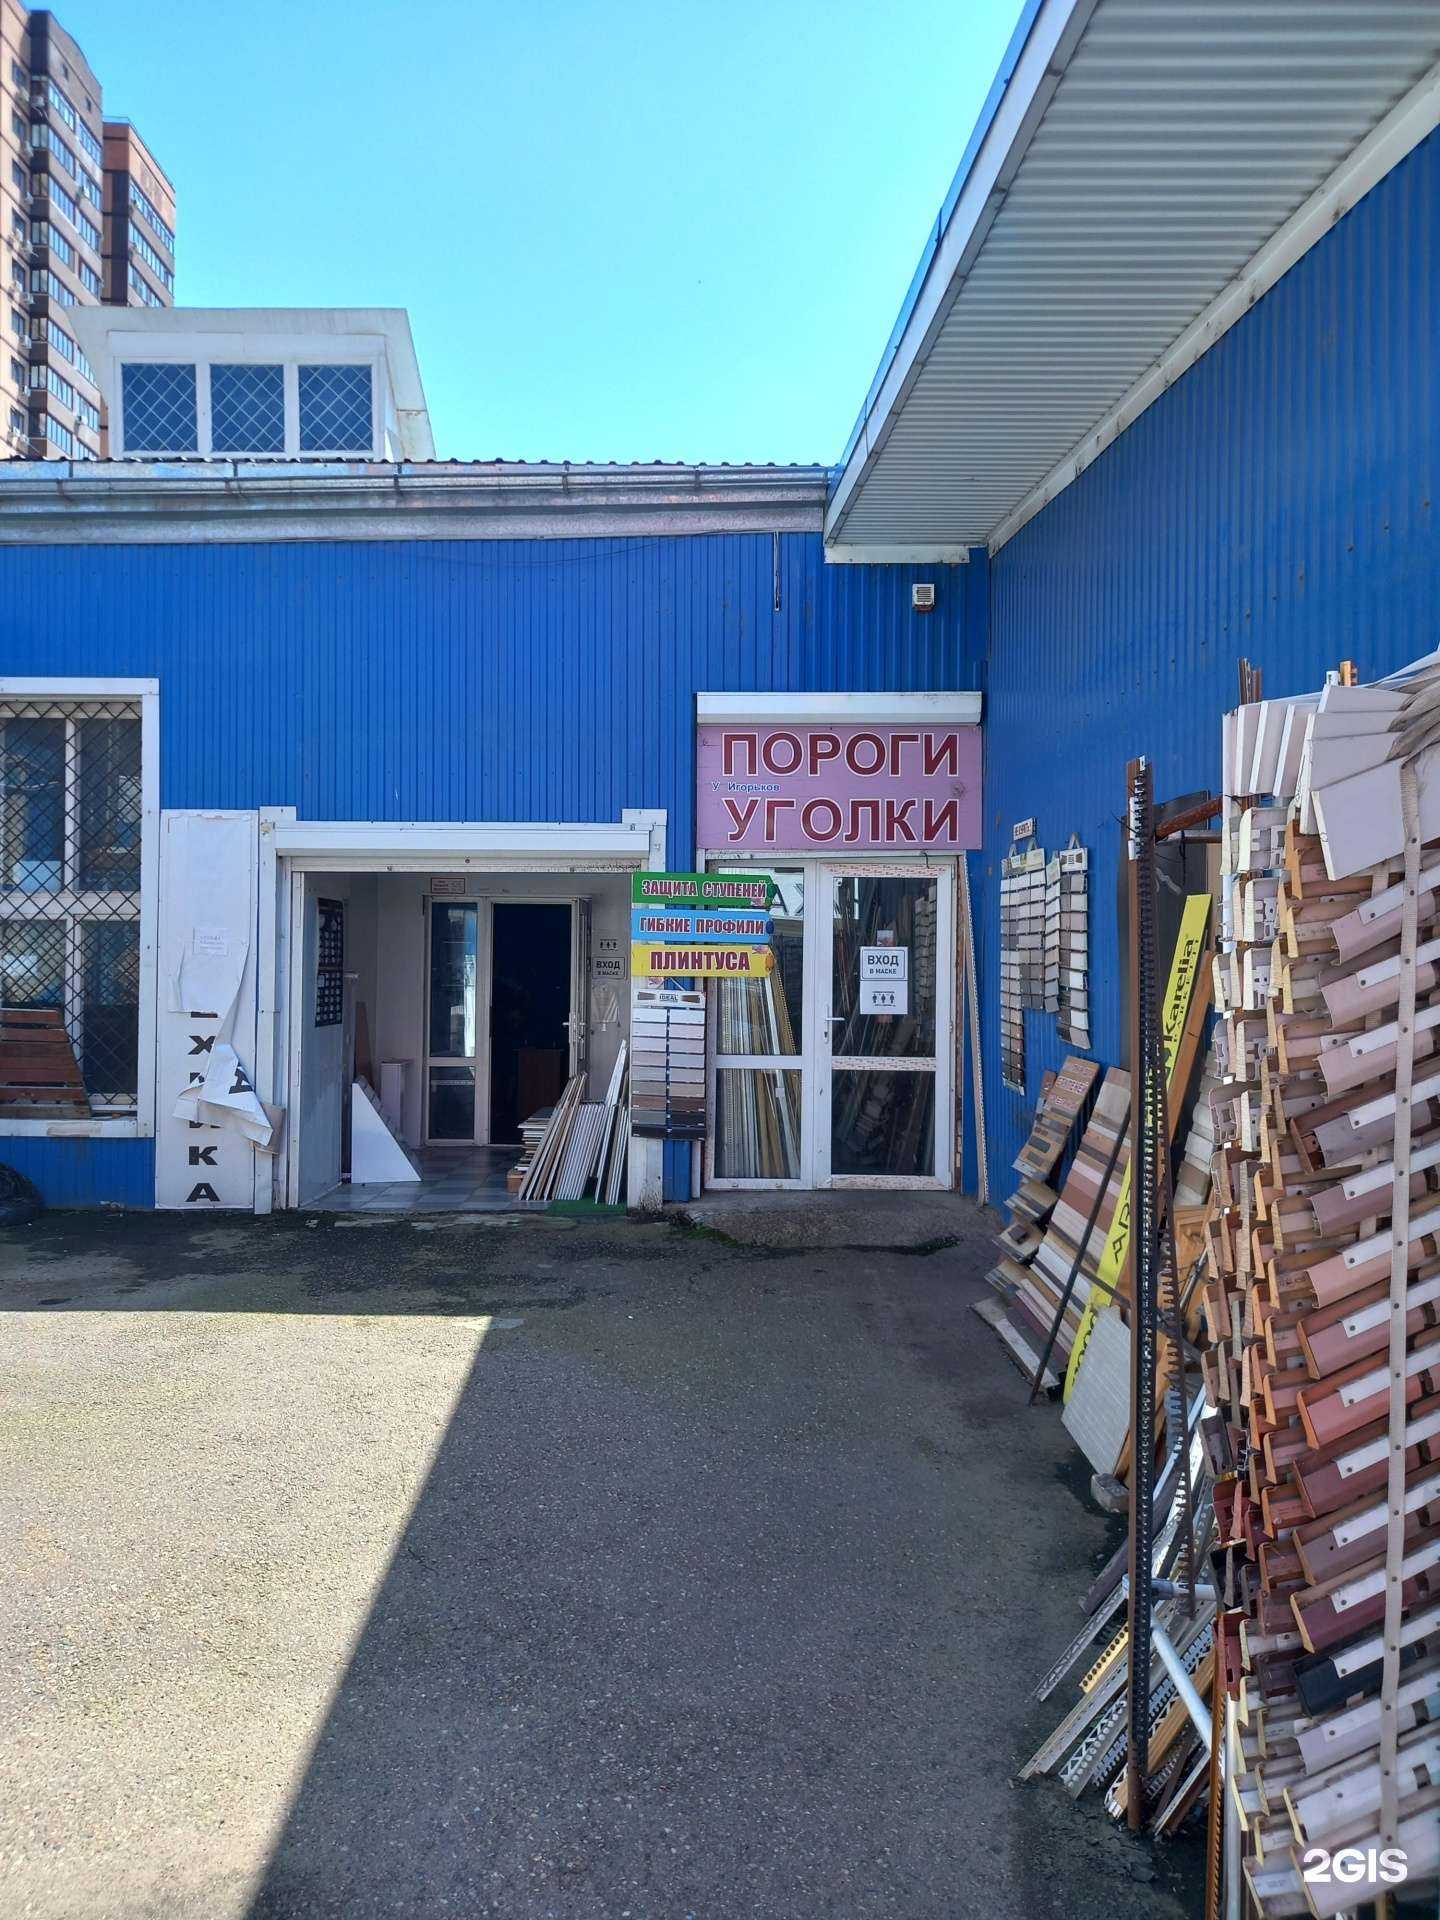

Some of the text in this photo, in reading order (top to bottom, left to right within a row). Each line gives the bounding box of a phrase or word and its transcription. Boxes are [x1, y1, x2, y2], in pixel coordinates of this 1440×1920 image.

[722, 731, 960, 776] ПОРОГИ
[711, 780, 721, 792] У
[722, 797, 960, 842] УГОЛКИ
[642, 880, 767, 898] ЗАЩИТА СТУПЕНЕЙ
[640, 917, 765, 935] ГИБКИЕ ПРОФИЛИ
[596, 960, 621, 970] ВХОД
[650, 951, 751, 971] ПЛИНТУСА
[867, 955, 899, 967] ВХОД
[1163, 939, 1194, 1042] Karelia
